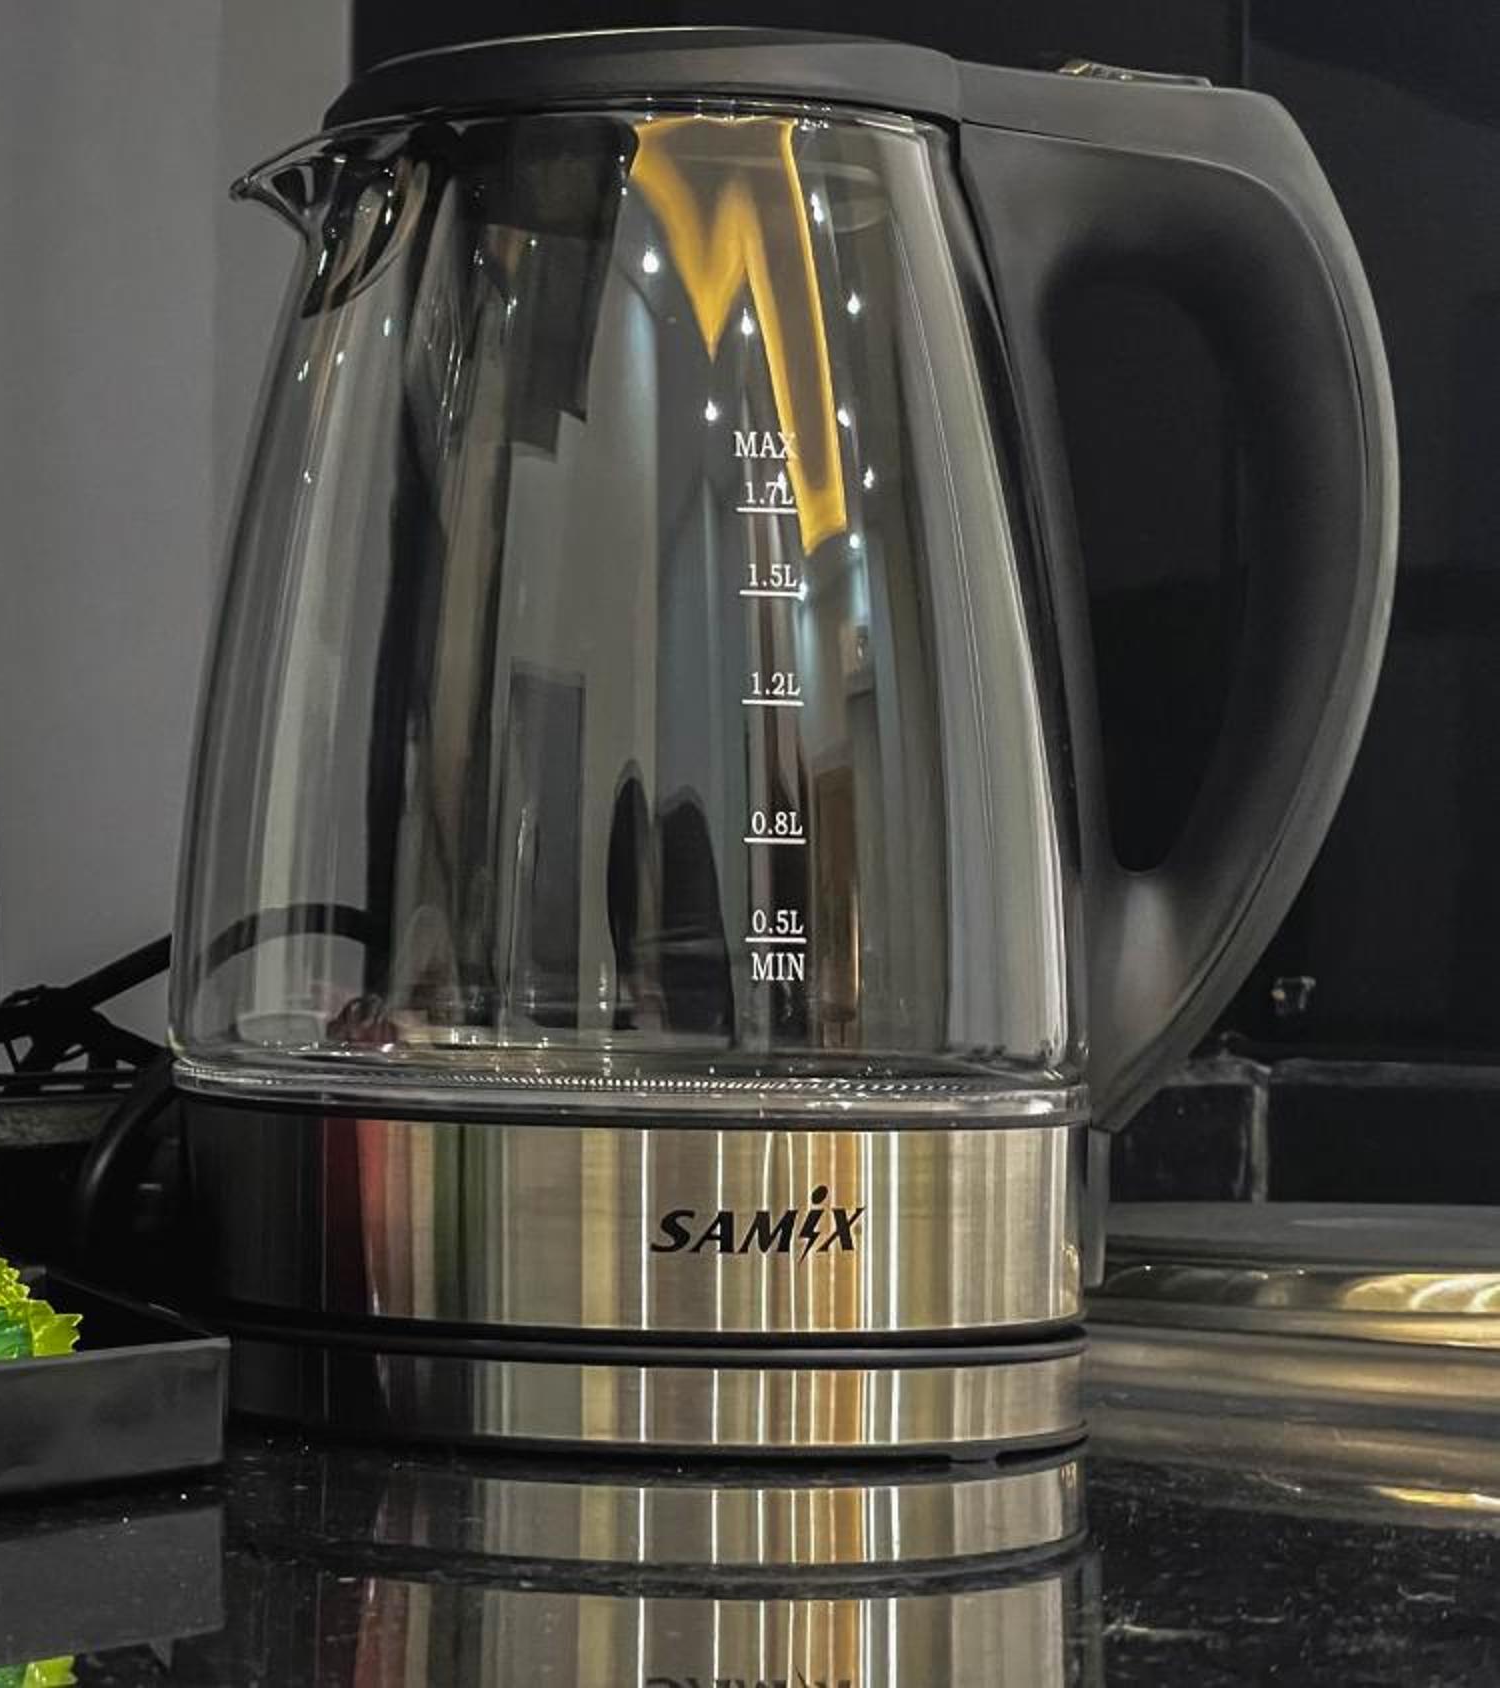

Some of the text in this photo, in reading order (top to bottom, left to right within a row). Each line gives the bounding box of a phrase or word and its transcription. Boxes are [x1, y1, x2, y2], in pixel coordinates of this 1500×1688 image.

[733, 430, 799, 459] MAX
[745, 481, 794, 505] 1.7L
[748, 563, 798, 588] 1.5L
[751, 673, 801, 696] 1.2L
[751, 812, 803, 836] 0.8L
[752, 910, 804, 935] 0.5L
[750, 952, 805, 981] MIN
